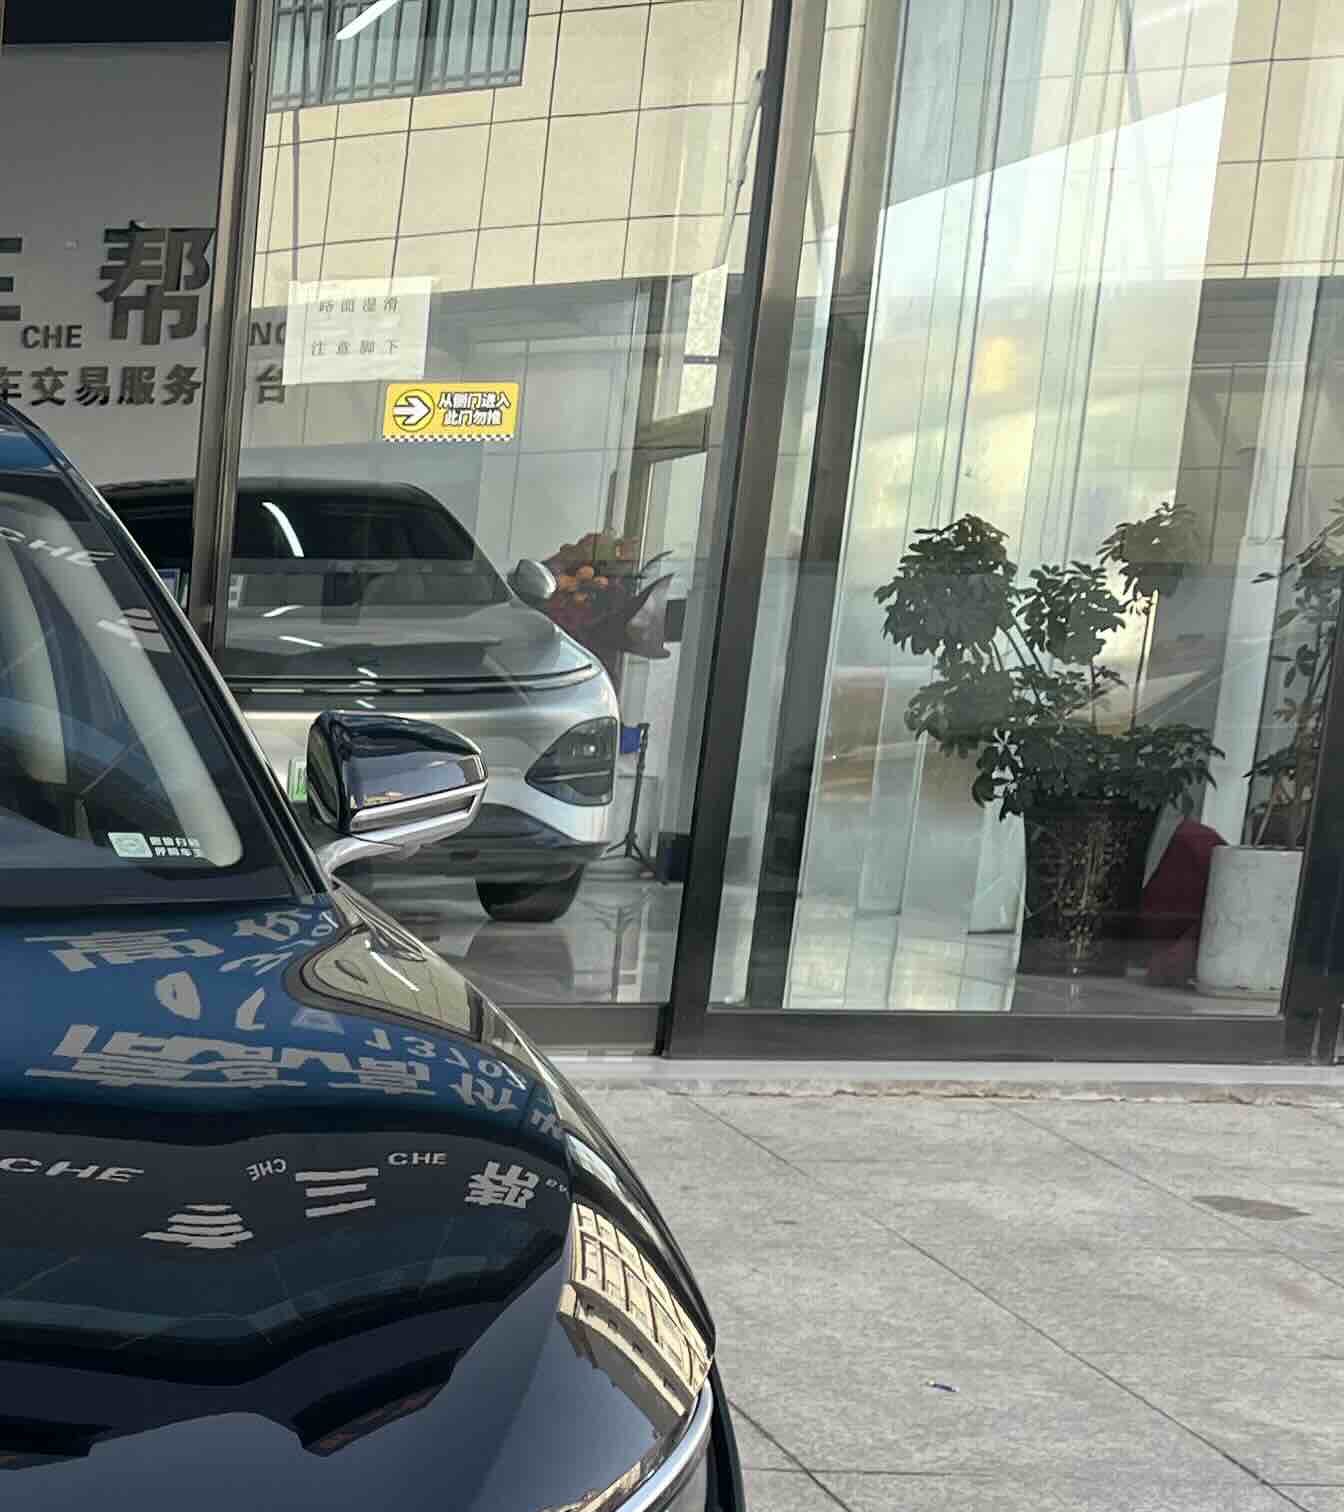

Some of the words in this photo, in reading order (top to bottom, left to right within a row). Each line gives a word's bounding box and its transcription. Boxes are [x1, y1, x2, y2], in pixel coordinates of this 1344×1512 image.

[23, 324, 82, 349] CHE
[438, 391, 511, 409] 从侧门进入
[443, 409, 503, 427] 此门勿推
